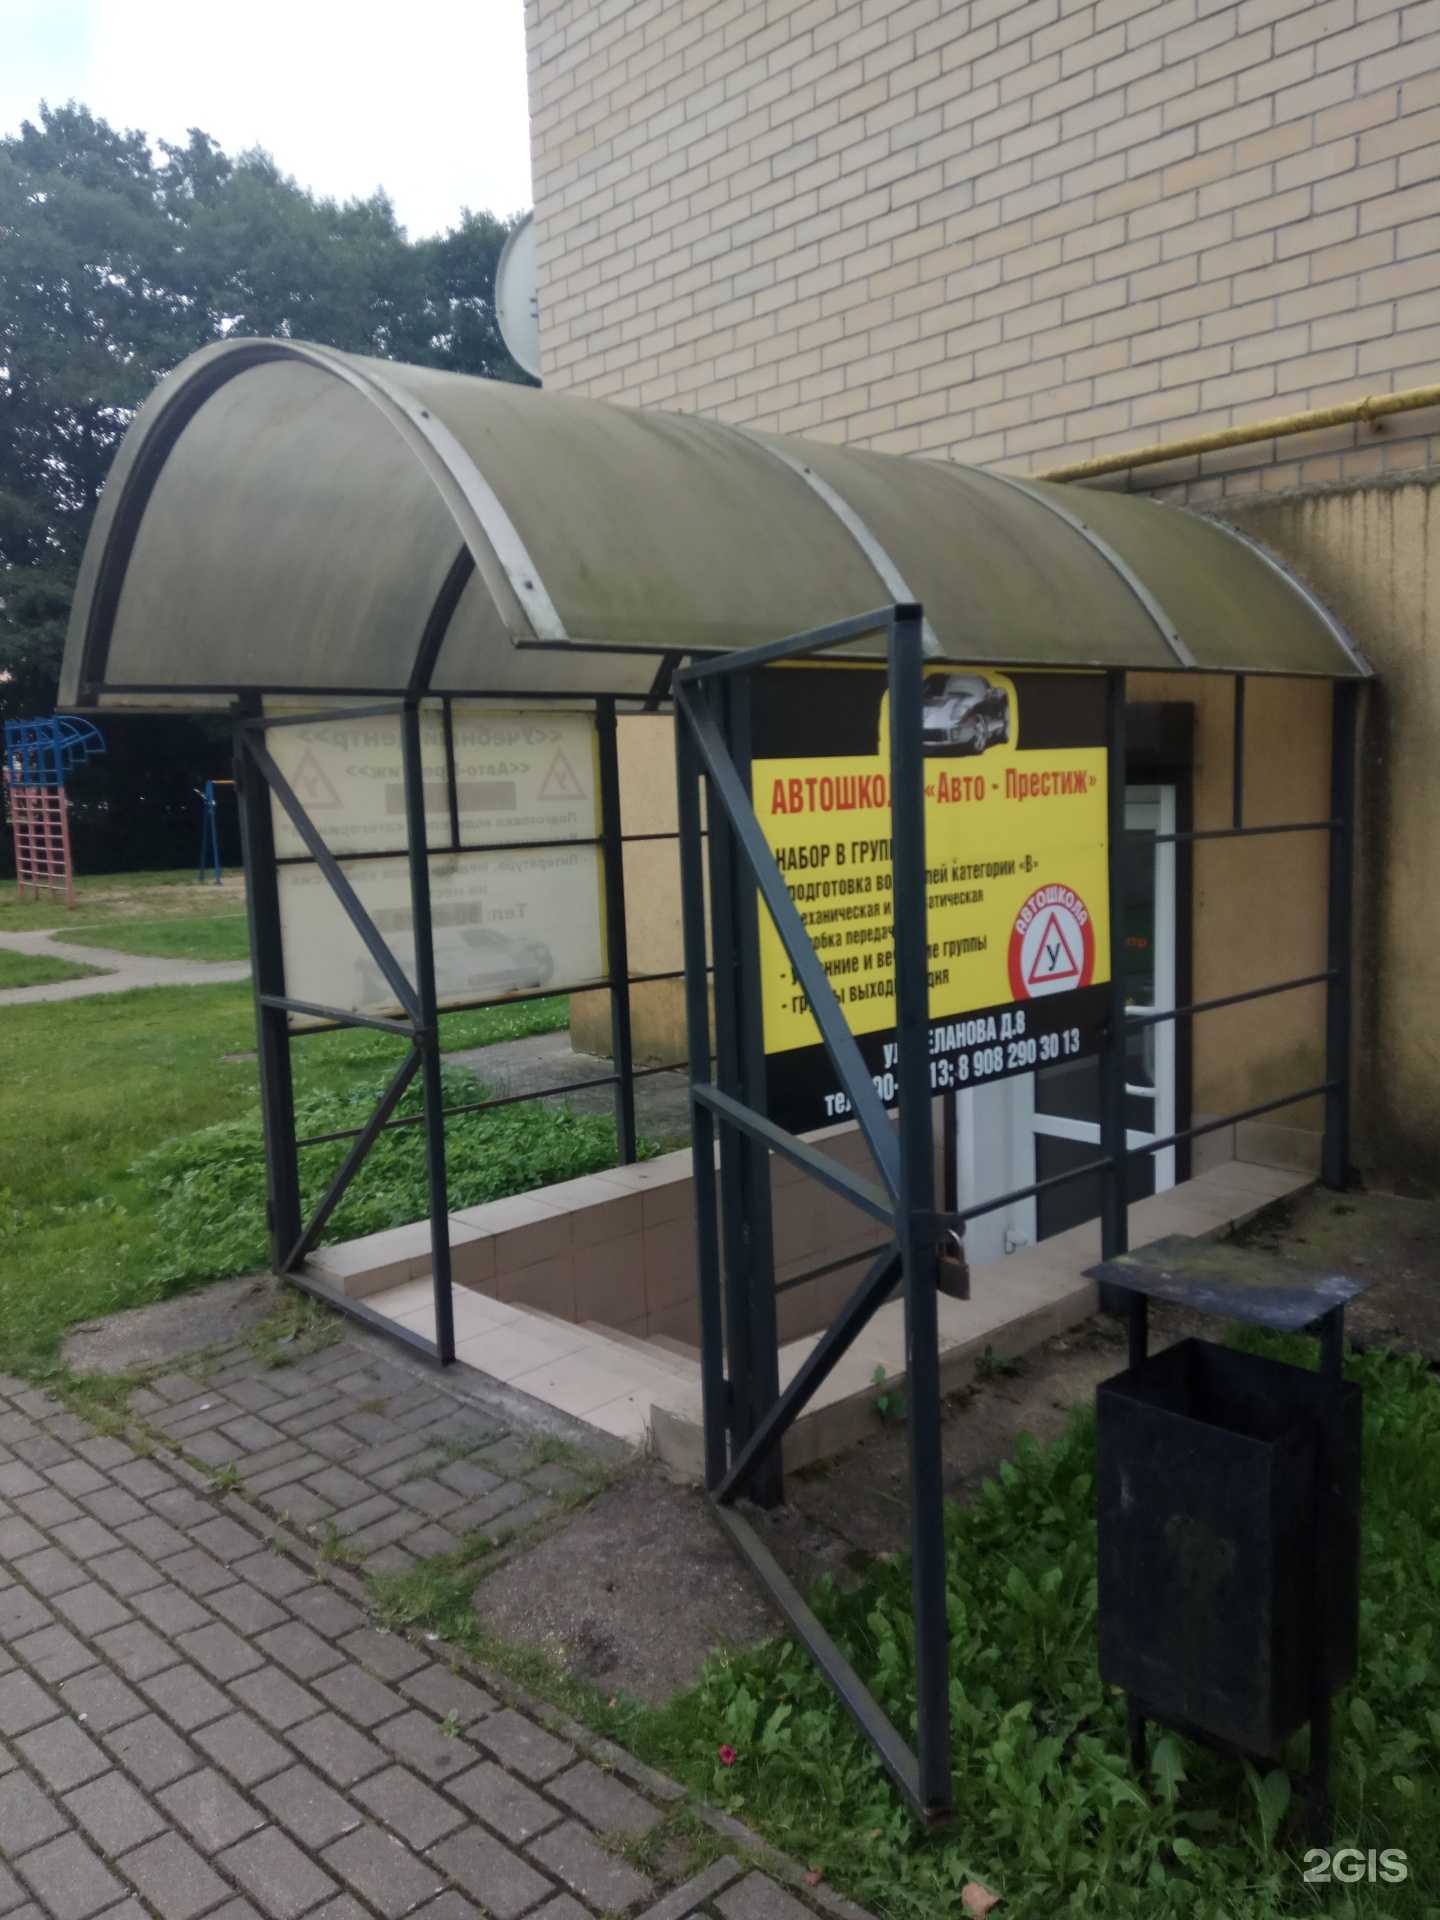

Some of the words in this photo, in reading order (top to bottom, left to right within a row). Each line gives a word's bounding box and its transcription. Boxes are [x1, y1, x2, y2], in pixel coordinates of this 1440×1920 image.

[771, 773, 893, 815] АВТОШКО
[925, 772, 985, 803] «Авто
[1005, 768, 1096, 801] Престиж»
[775, 844, 830, 871] НАБОР
[836, 842, 845, 866] В
[800, 902, 881, 926] еханическая
[863, 953, 873, 971] и
[1000, 1010, 1026, 1041] Д.8
[958, 1054, 969, 1081] 8
[973, 1046, 1004, 1078] 908
[1007, 1038, 1036, 1069] 290
[1040, 1032, 1059, 1061] 30
[1062, 1027, 1080, 1054] 13
